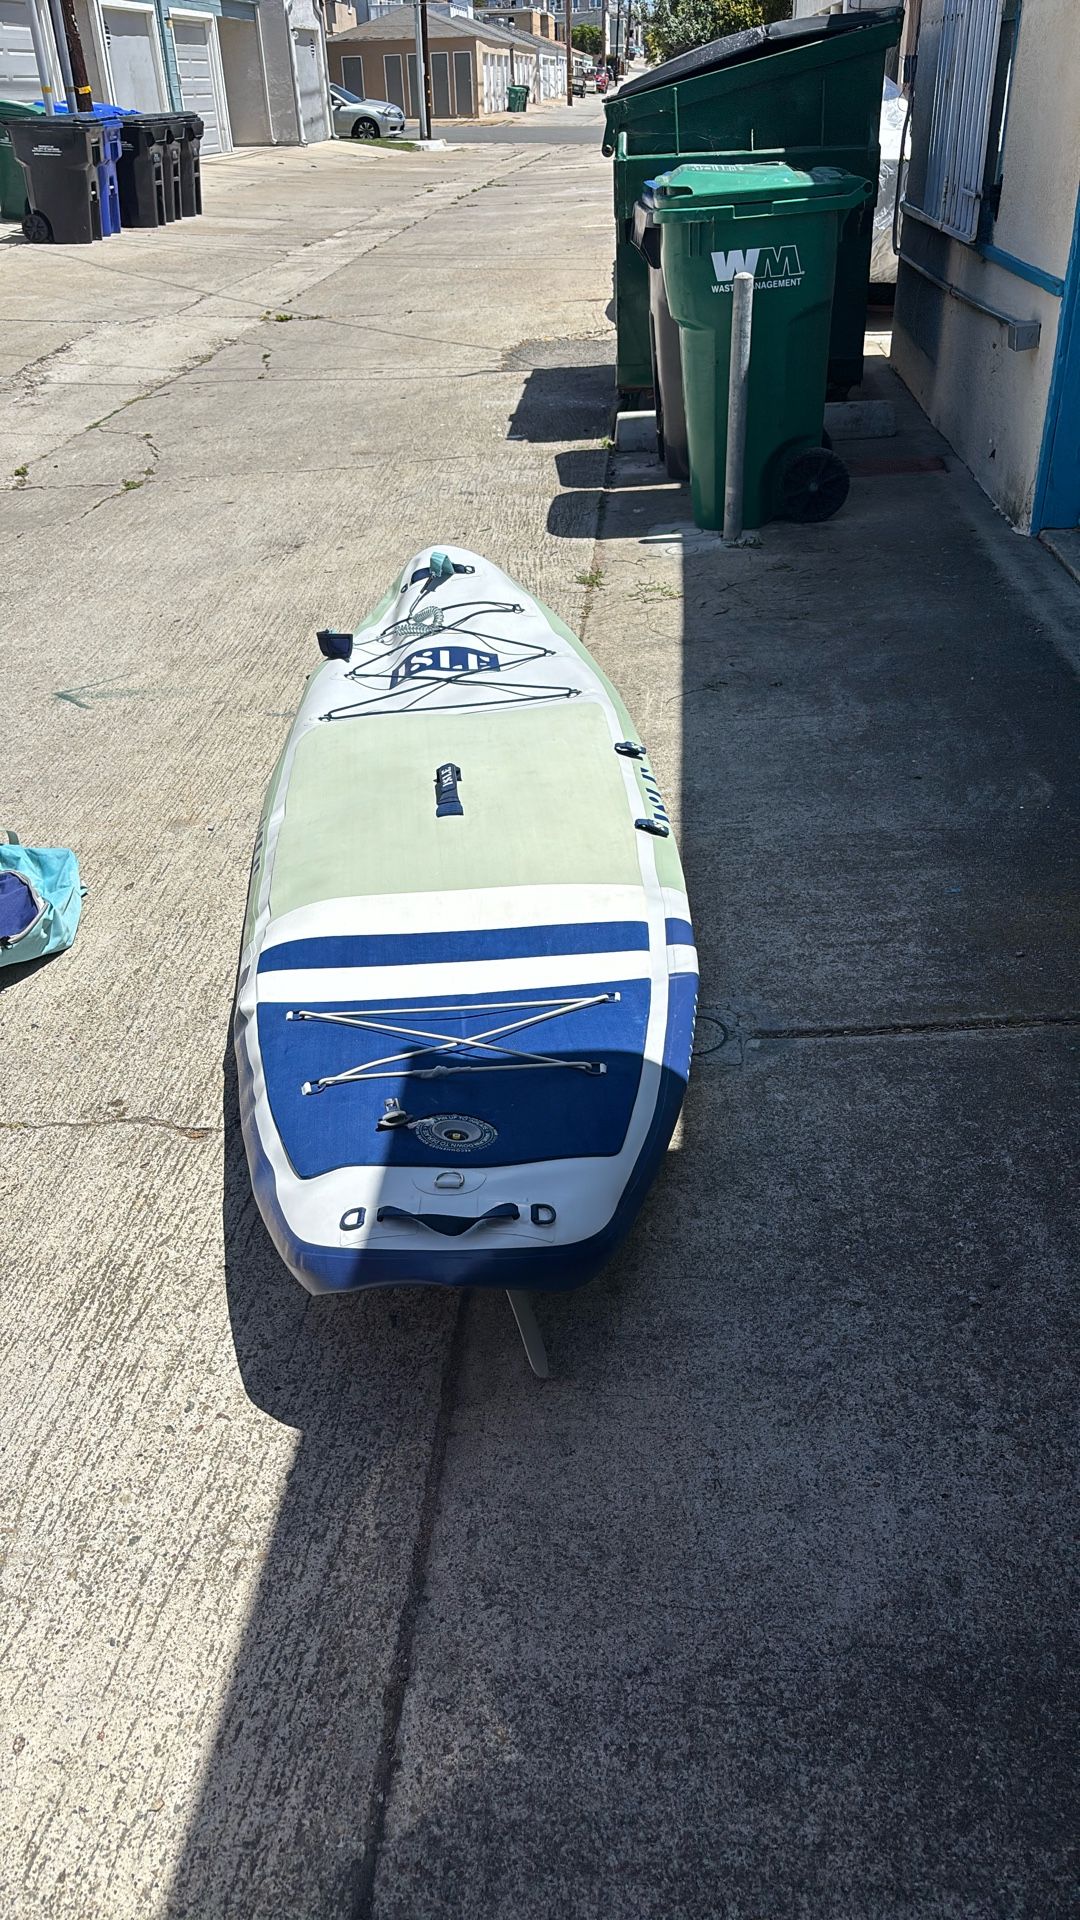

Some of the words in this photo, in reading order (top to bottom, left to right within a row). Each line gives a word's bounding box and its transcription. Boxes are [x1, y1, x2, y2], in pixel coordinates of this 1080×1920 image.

[711, 245, 801, 281] WM
[711, 284, 734, 293] WAST
[397, 650, 491, 682] ISLE
[441, 766, 453, 787] ISLE
